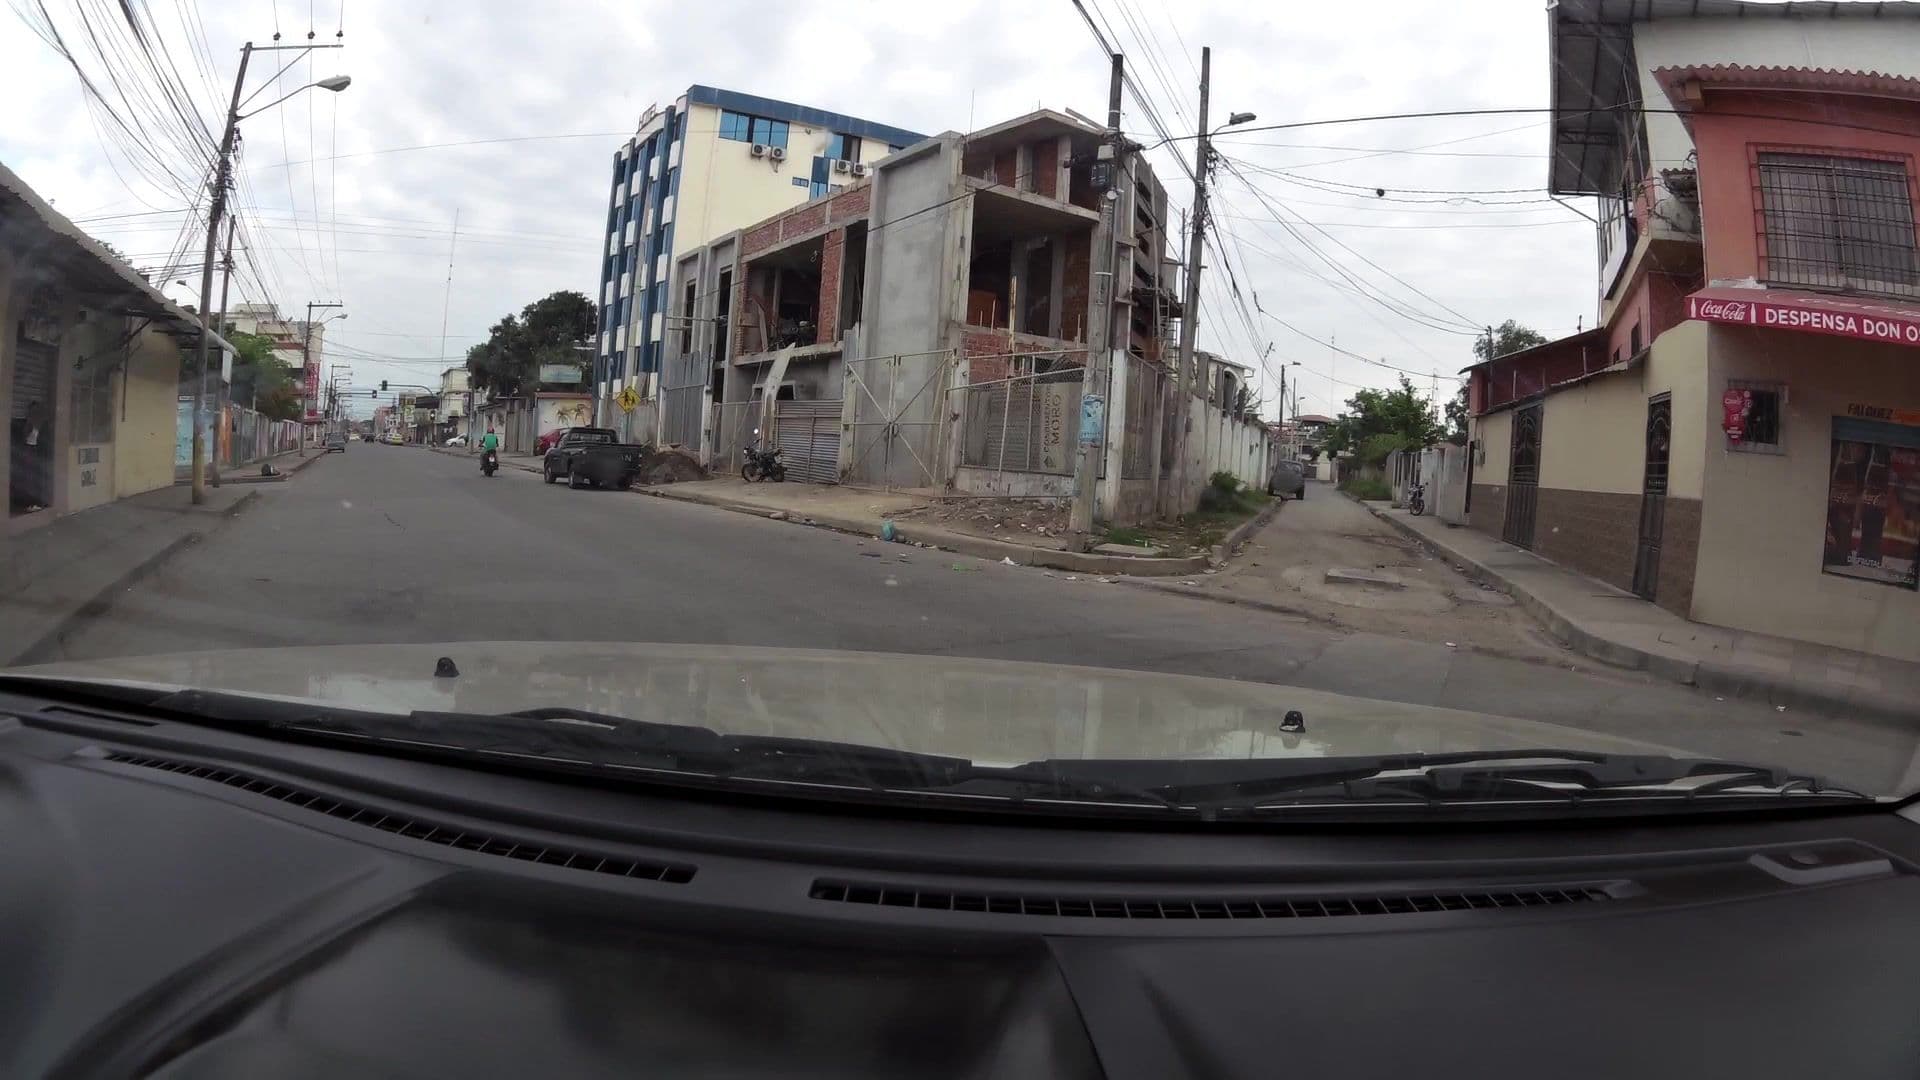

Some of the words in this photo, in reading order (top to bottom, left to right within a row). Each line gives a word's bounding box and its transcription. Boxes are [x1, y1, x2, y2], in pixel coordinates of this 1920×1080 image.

[1765, 308, 1858, 333] DESPENSA
[1863, 319, 1901, 339] DON
[1906, 325, 1920, 342] O
